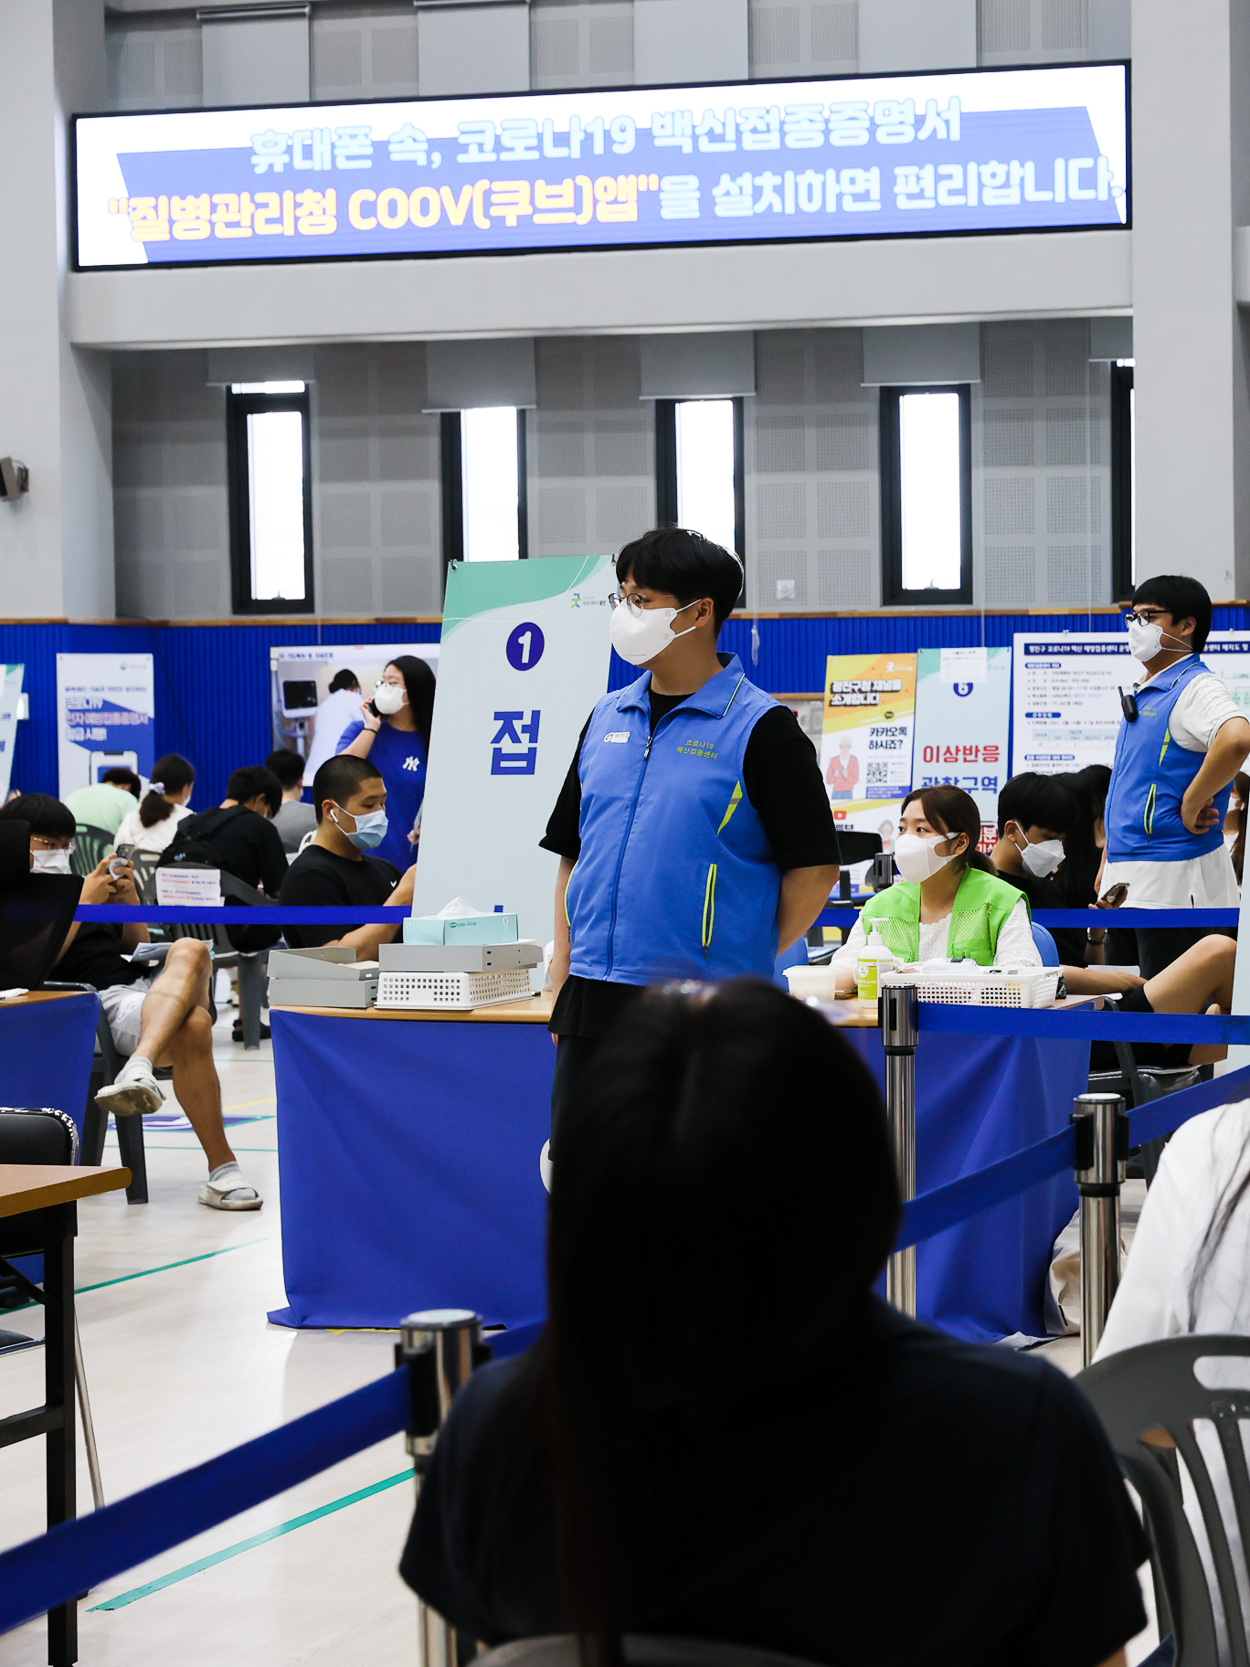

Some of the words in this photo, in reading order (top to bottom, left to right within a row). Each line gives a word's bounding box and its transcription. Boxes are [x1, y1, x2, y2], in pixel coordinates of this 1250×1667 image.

[250, 125, 374, 174] 휴대폰
[388, 122, 442, 169] 속,
[456, 114, 637, 164] 코로나19
[651, 95, 962, 153] 백신접종증명서
[108, 188, 338, 242] "질병관리청
[347, 172, 701, 231] COOV(쿠브)앱"을
[711, 165, 882, 218] 설치하면
[489, 709, 541, 776] 접
[868, 740, 904, 751] 하시죠?
[869, 726, 908, 738] 카카오톡
[923, 745, 1001, 764] 이상반응
